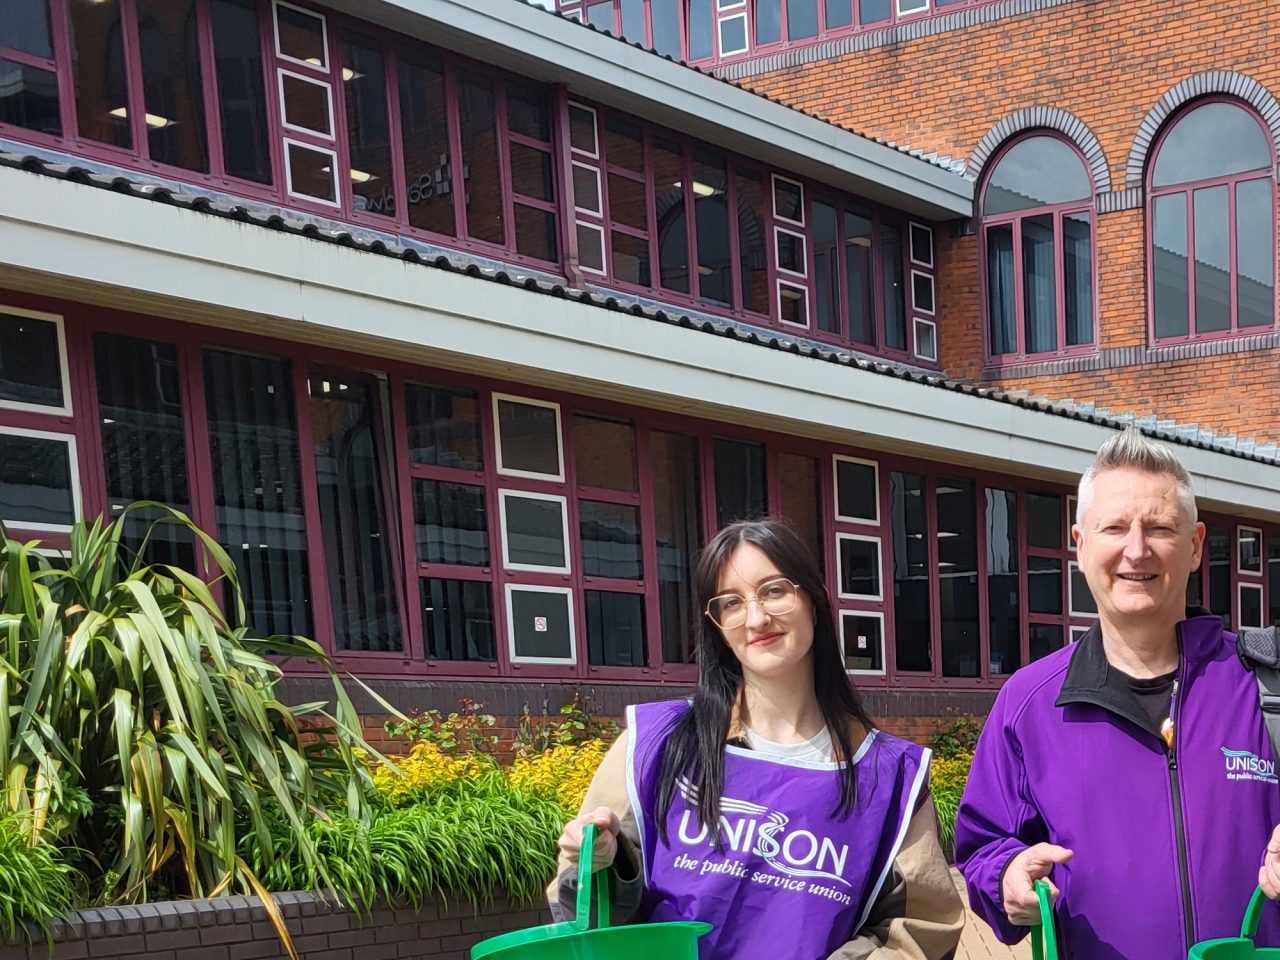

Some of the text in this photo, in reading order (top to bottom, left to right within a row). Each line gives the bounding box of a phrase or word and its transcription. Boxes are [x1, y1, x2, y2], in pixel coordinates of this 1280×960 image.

[1225, 756, 1275, 774] UNISON
[678, 809, 849, 877] UNISON
[673, 853, 852, 905] the public service union
